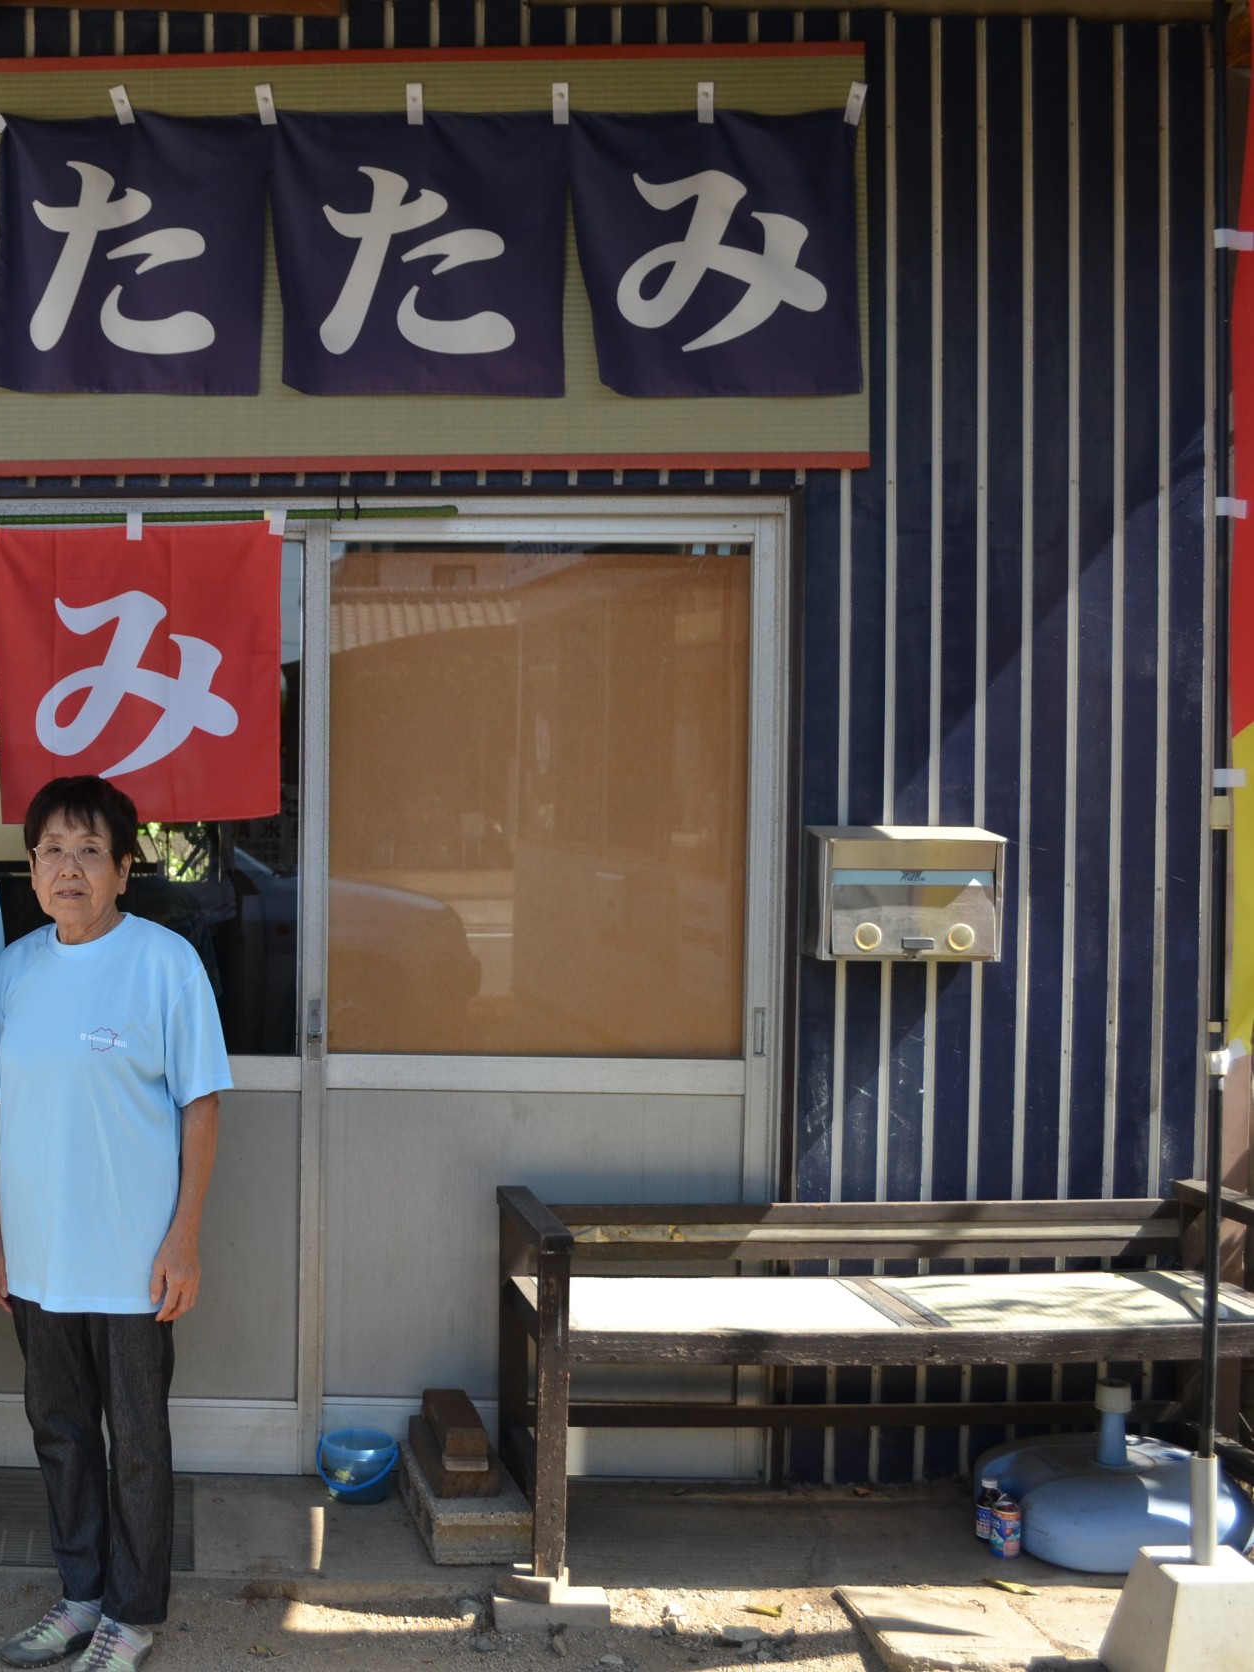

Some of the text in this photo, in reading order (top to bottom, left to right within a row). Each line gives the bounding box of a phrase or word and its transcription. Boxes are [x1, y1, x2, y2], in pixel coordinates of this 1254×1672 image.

[29, 160, 828, 355] たたみ
[230, 821, 298, 838] 清水
